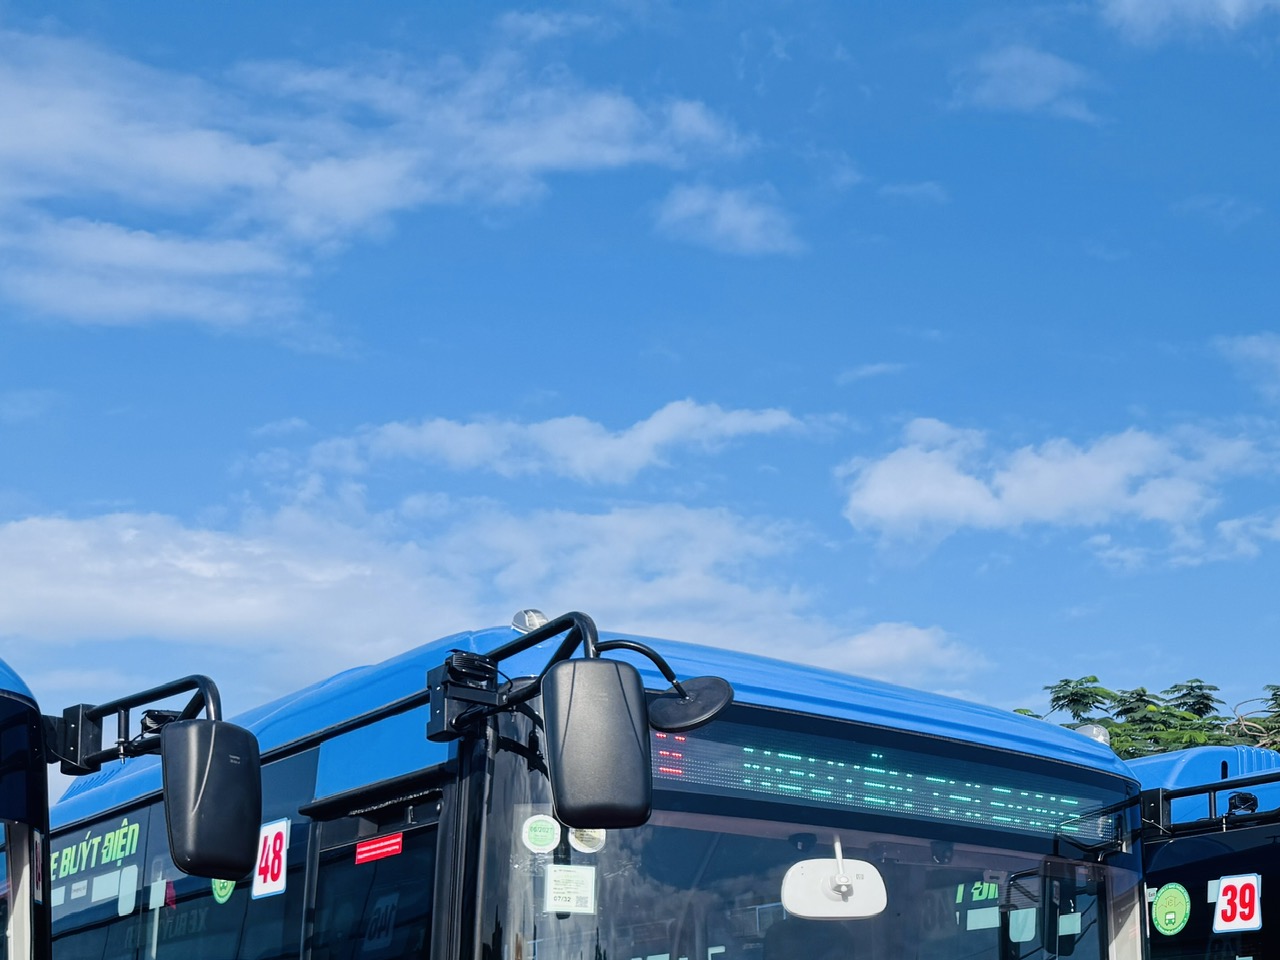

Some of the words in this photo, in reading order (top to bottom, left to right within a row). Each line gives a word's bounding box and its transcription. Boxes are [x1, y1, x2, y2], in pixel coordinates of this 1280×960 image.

[59, 830, 101, 879] BUÝT
[101, 817, 140, 867] ĐIỆN
[258, 831, 284, 884] 48
[1221, 883, 1256, 923] 39
